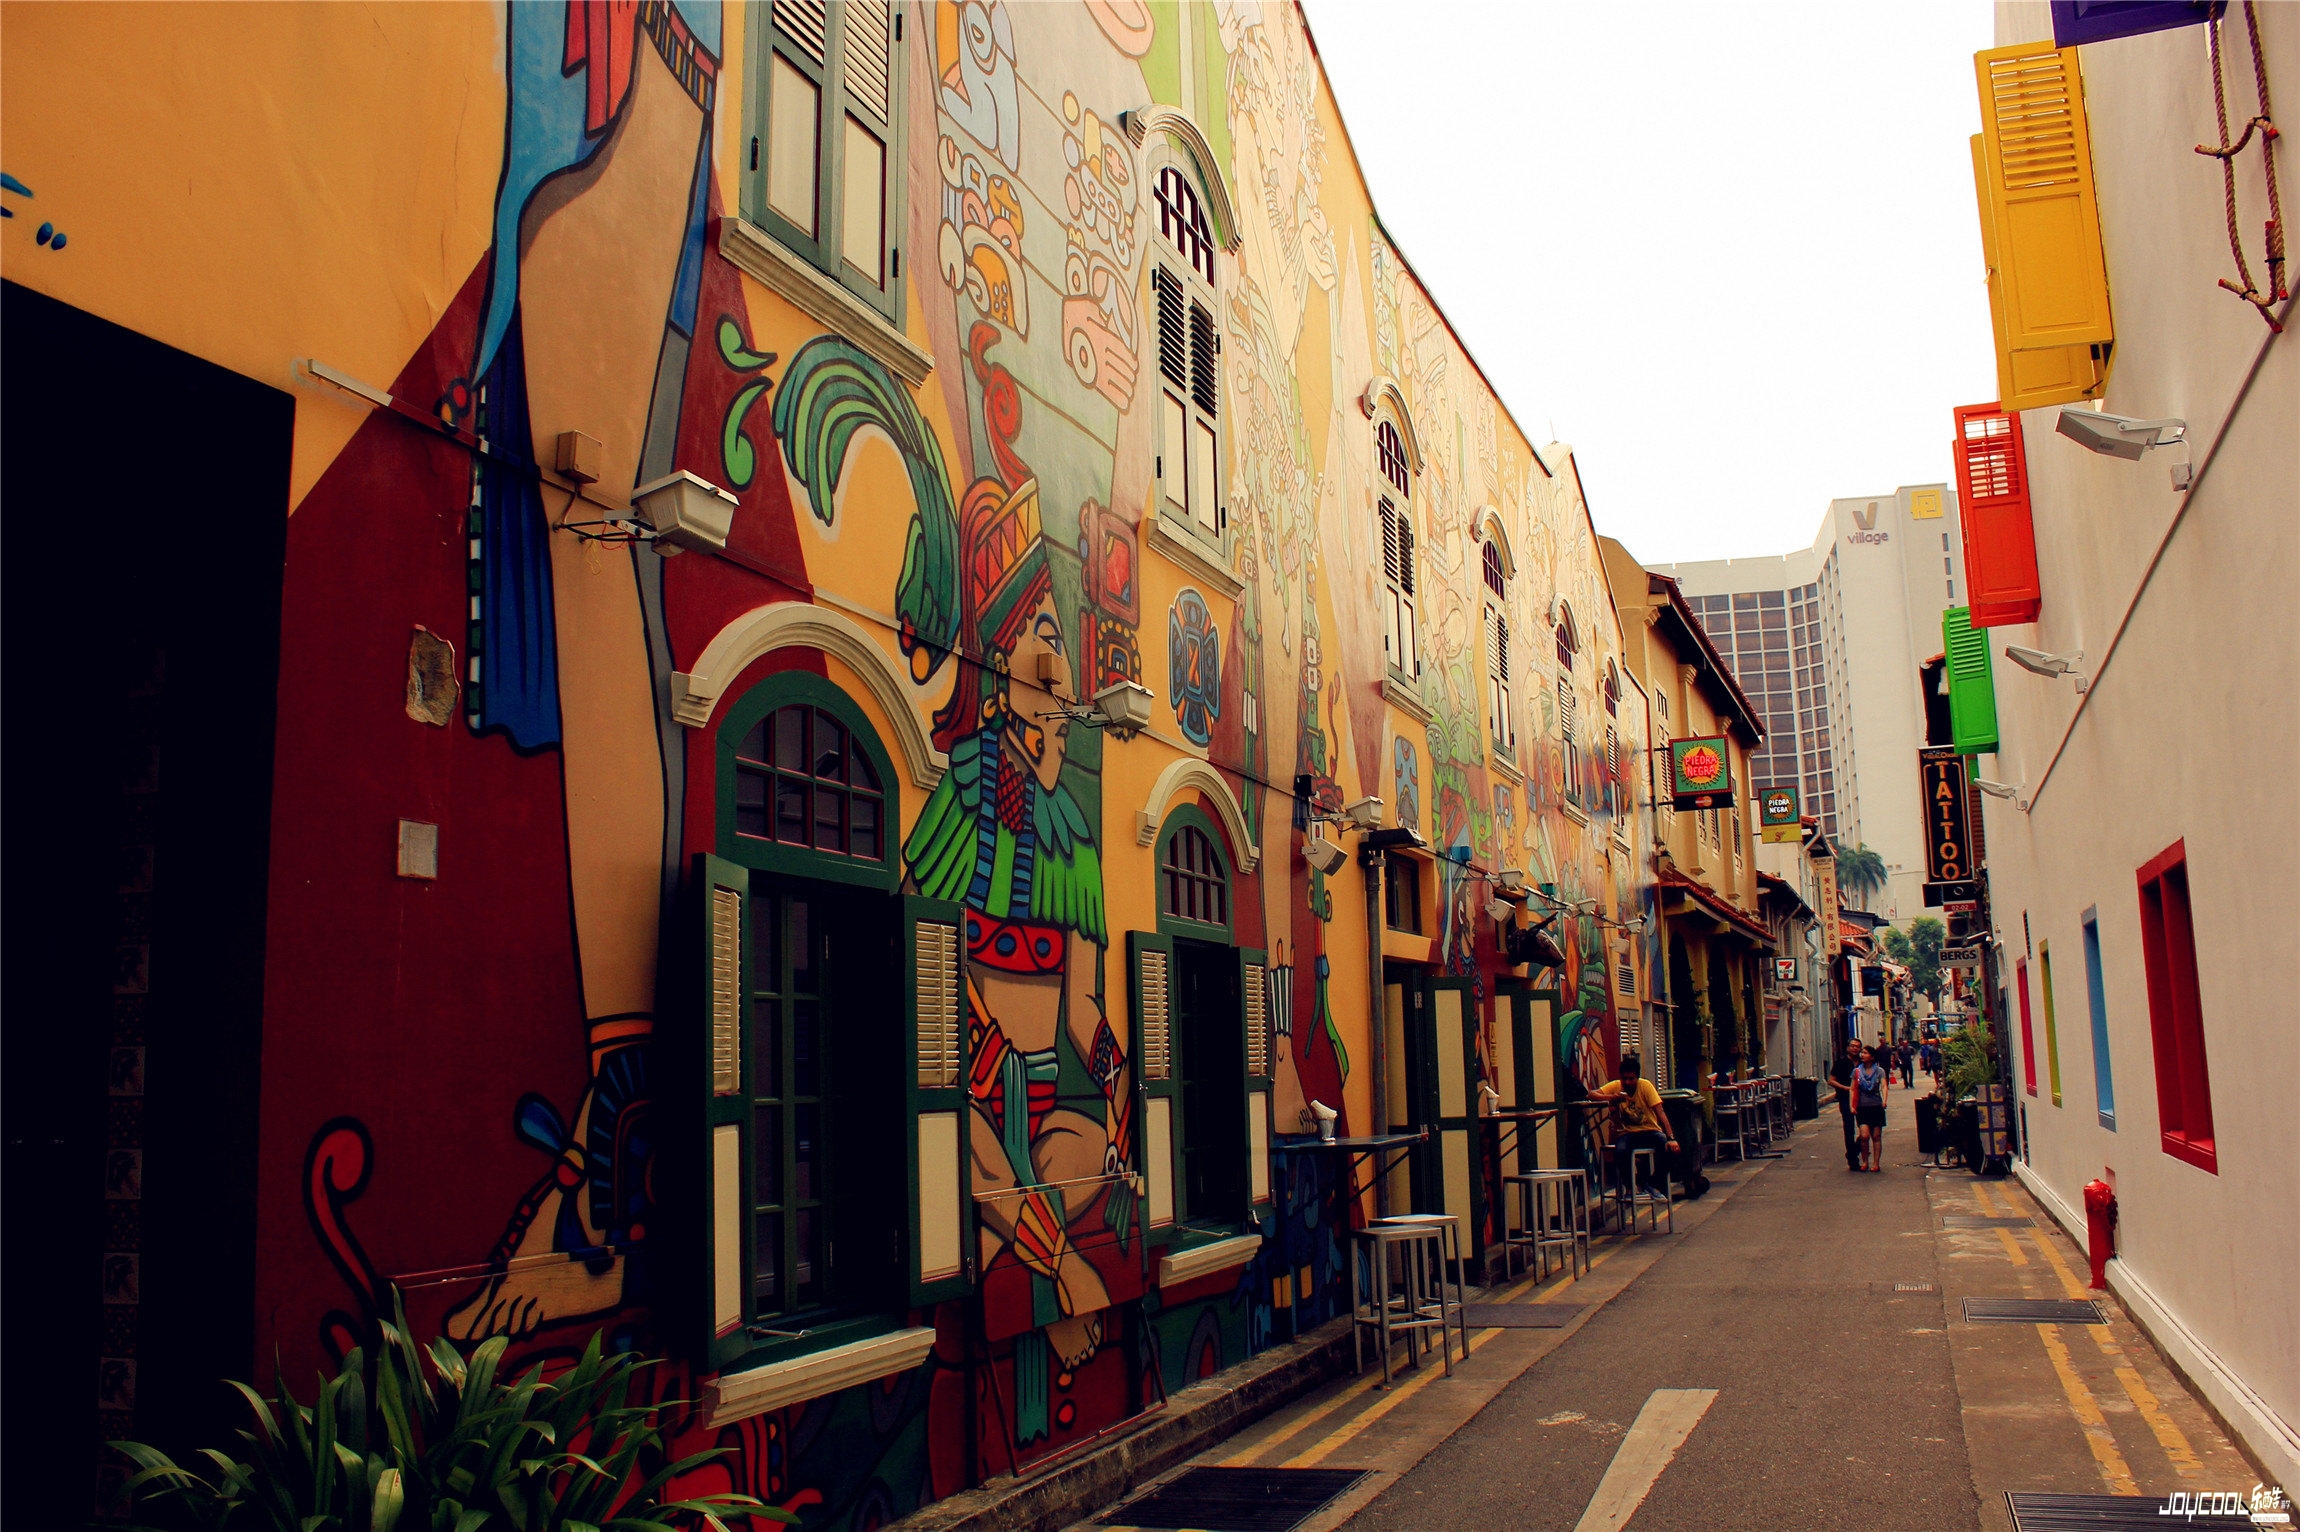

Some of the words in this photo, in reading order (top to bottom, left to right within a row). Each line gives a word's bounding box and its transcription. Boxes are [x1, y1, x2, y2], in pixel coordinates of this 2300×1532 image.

[1847, 532, 1889, 545] village
[1685, 755, 1717, 766] PIEDRA
[1687, 765, 1716, 777] NEGRA
[1769, 798, 1790, 807] PIEDRA
[1770, 806, 1789, 814] NEGRA
[1935, 761, 1960, 880] TATTOO
[1940, 949, 1977, 961] BERGS
